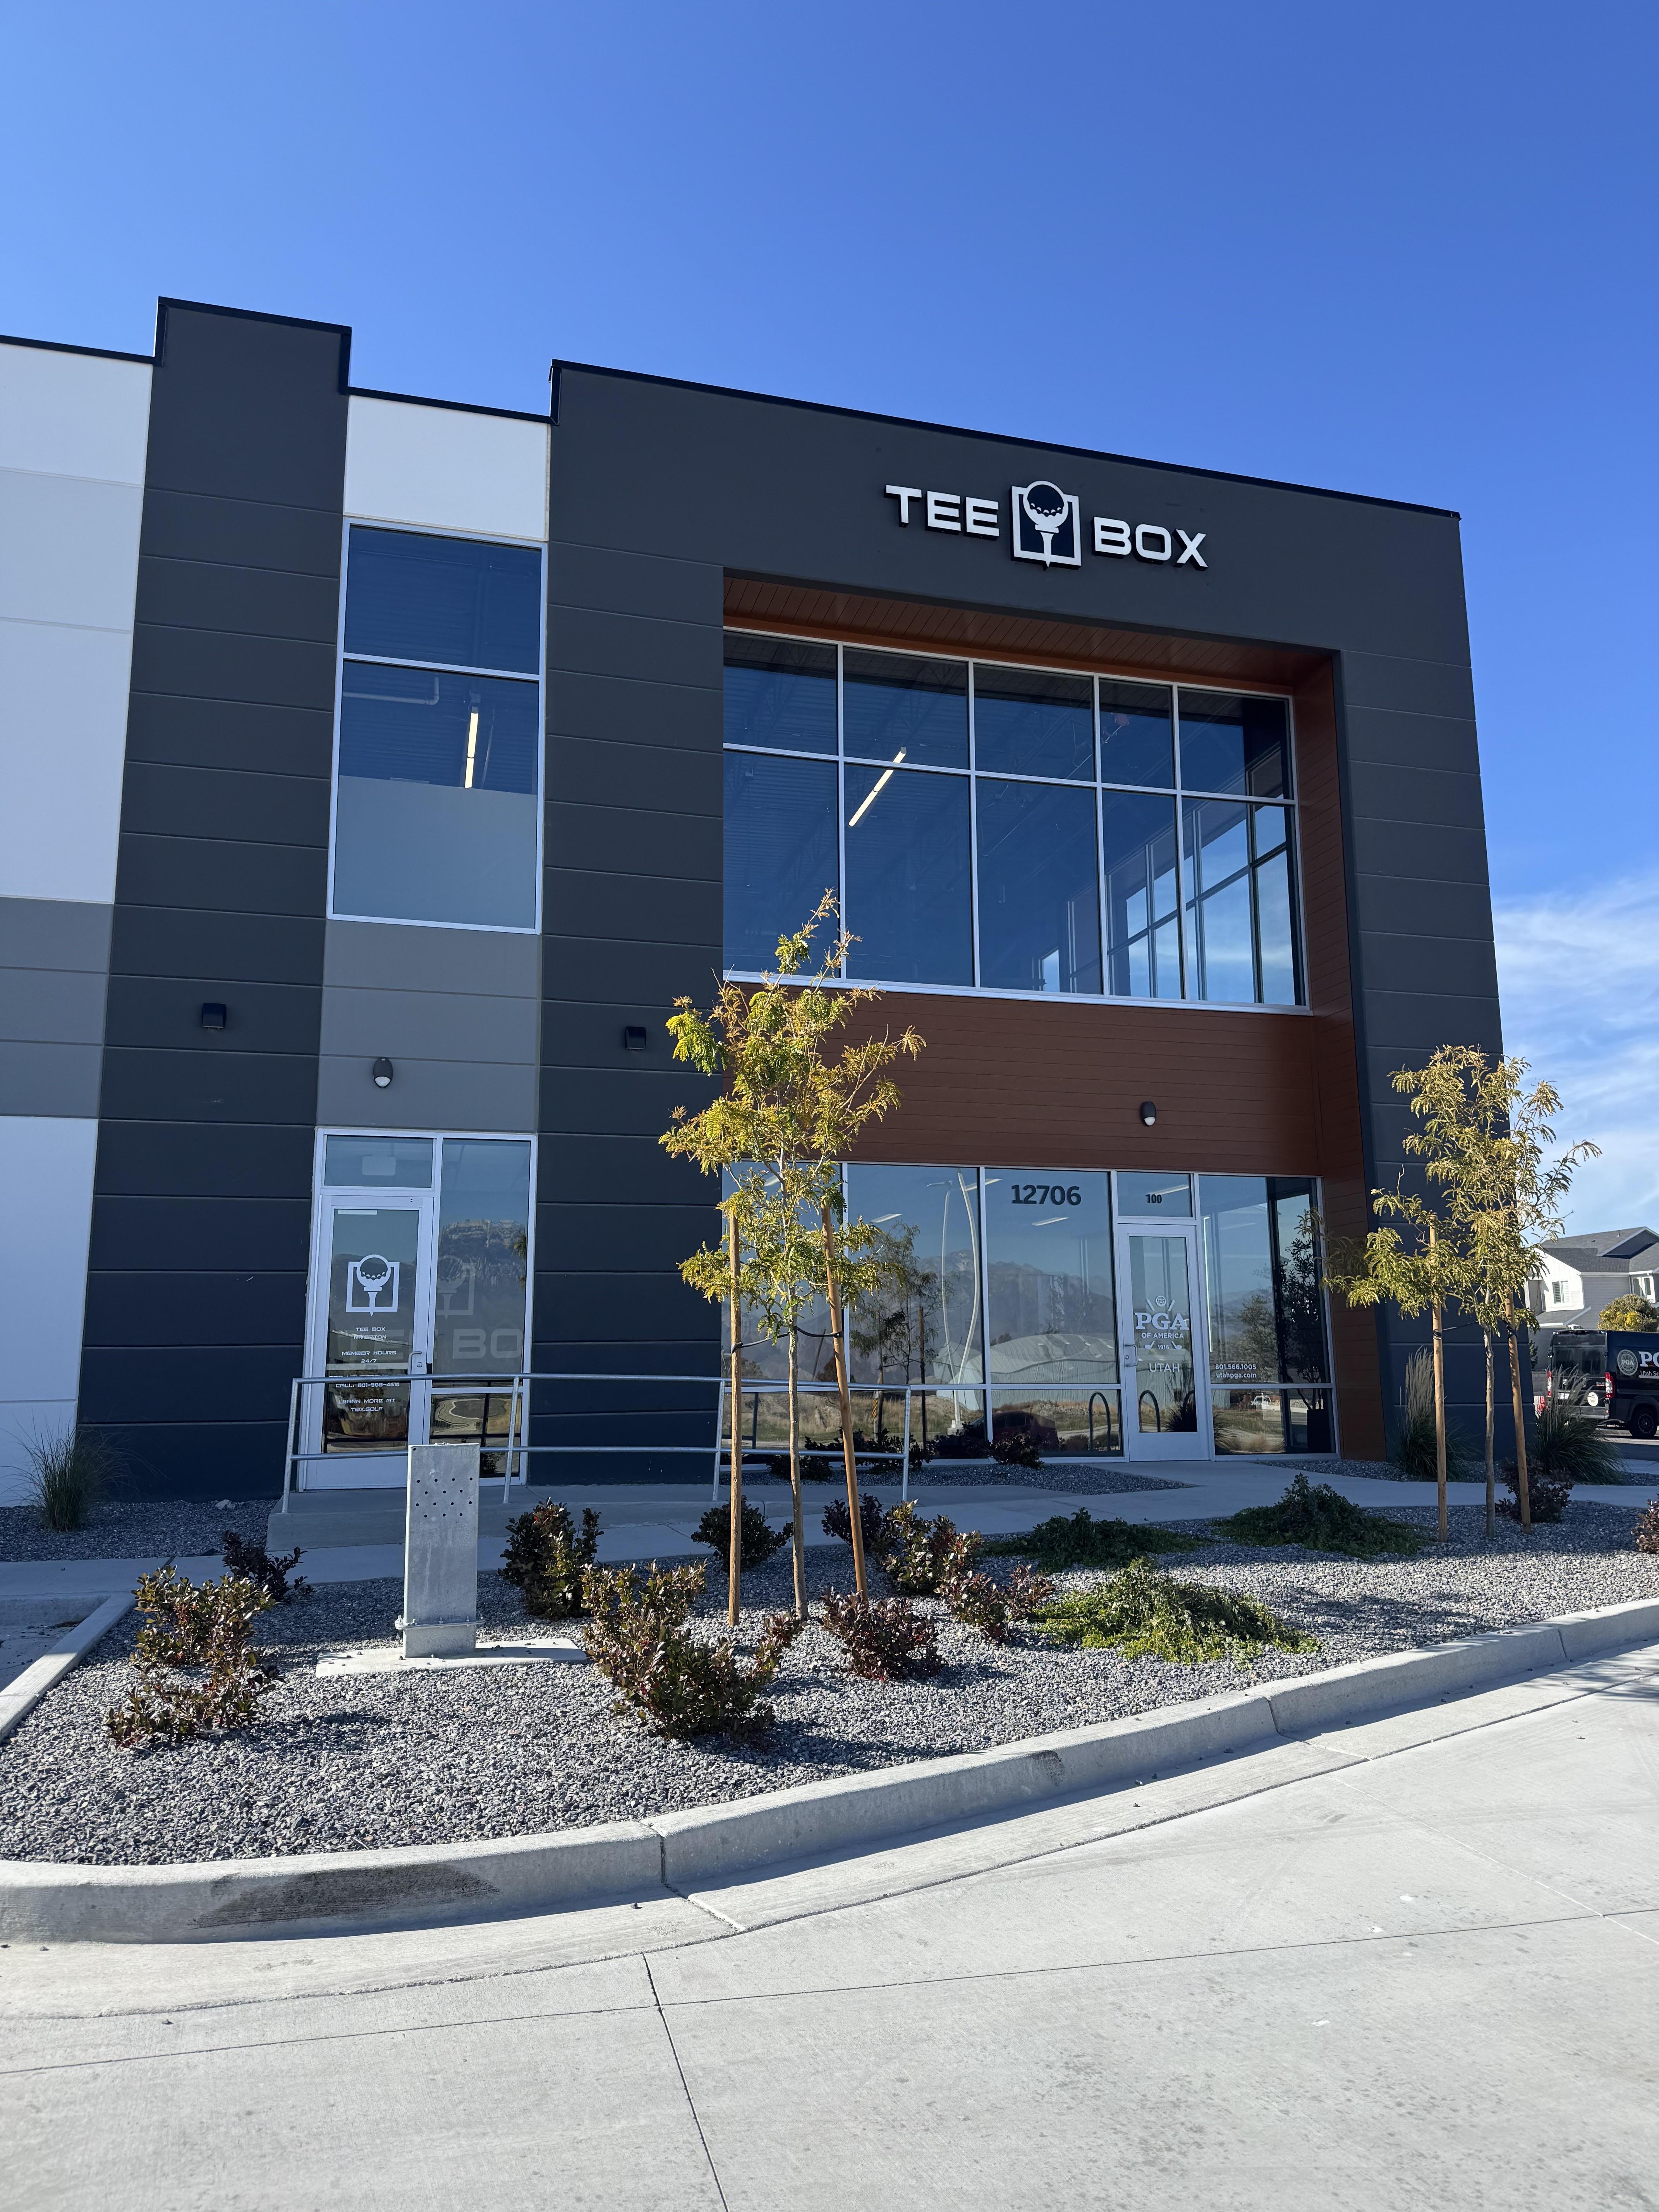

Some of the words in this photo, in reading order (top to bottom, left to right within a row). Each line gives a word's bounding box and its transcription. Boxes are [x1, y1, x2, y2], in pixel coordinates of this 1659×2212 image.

[884, 484, 1000, 539] TEE
[1092, 517, 1208, 570] BOX
[1012, 1184, 1082, 1206] 12706
[1146, 1194, 1162, 1204] 100
[1135, 1312, 1190, 1330] PGA
[1149, 1363, 1180, 1372] UTAH
